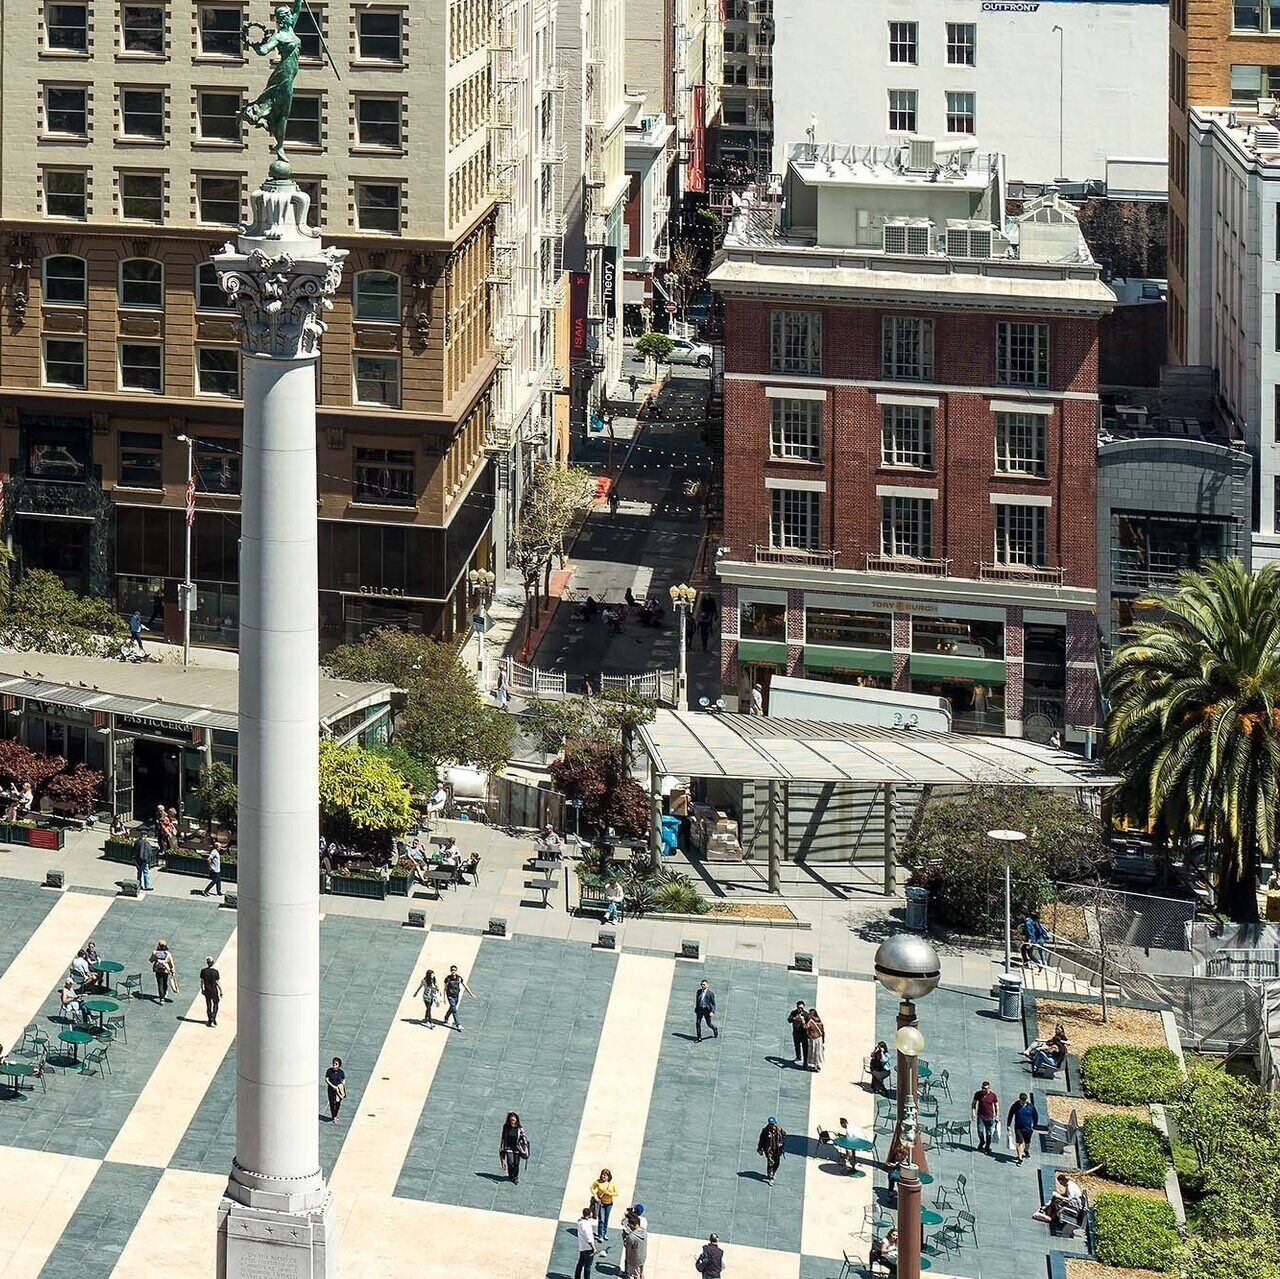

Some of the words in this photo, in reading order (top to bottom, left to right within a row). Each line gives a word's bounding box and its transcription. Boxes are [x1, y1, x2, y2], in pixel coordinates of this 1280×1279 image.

[982, 3, 1038, 12] OUTFRONT
[604, 261, 615, 301] Theory
[575, 317, 583, 348] ISAIA
[359, 585, 406, 598] GUCCI
[871, 601, 895, 609] TORY
[905, 603, 939, 612] BURCH
